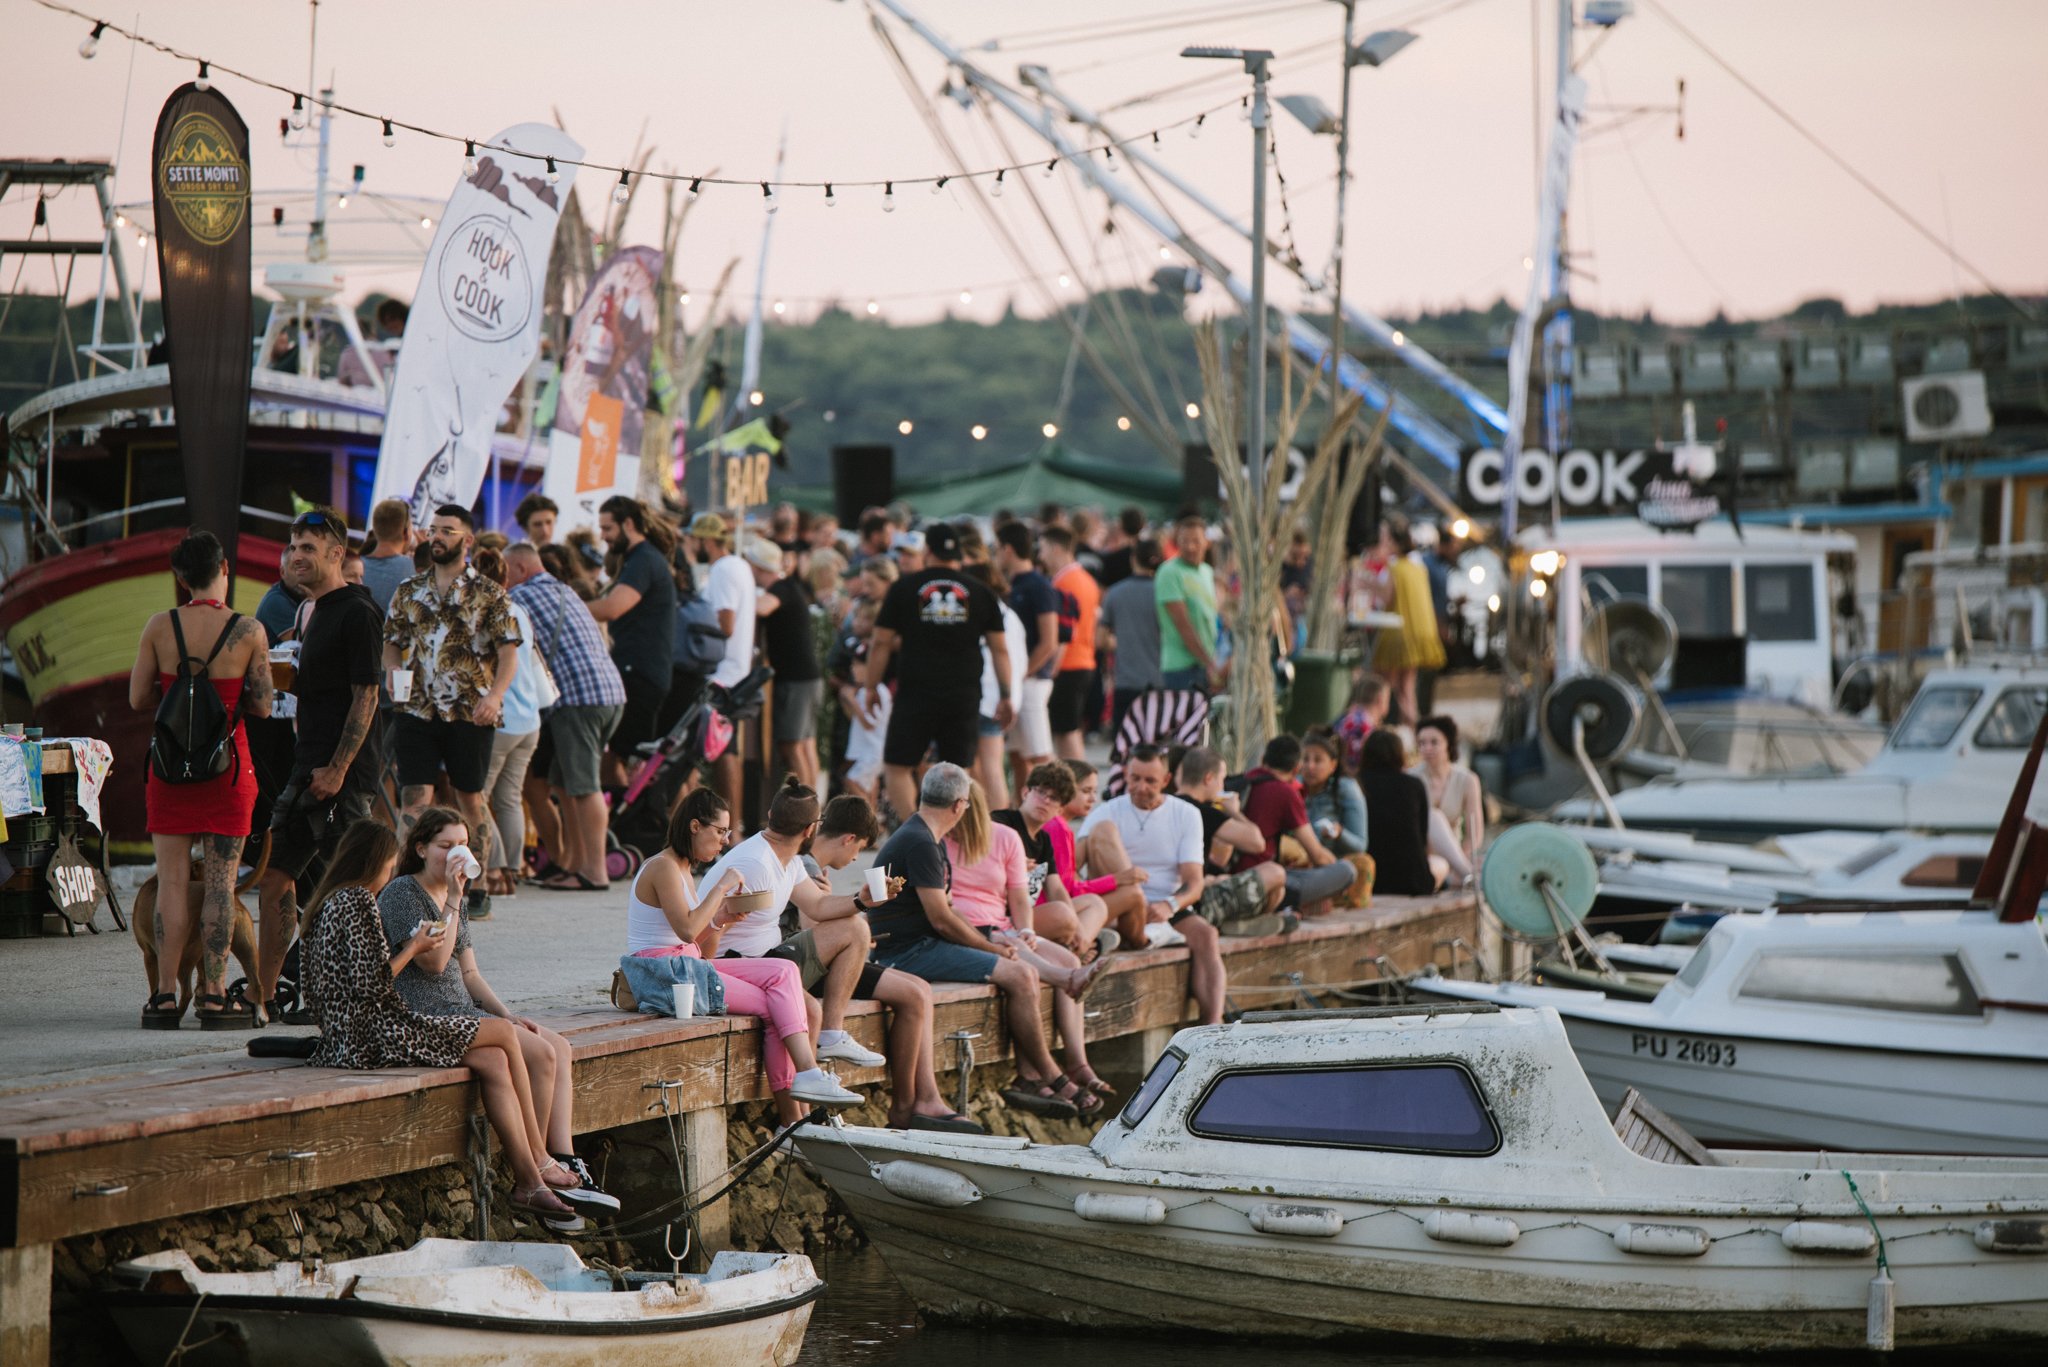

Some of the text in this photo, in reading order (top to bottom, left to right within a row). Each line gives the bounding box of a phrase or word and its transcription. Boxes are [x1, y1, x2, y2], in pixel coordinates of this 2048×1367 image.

[169, 166, 239, 182] SETTE MONTI
[467, 227, 516, 281] HOOK
[479, 266, 489, 284] &
[453, 274, 504, 325] COOK
[726, 452, 770, 510] BAR
[1466, 448, 1647, 506] COOK
[55, 865, 96, 908] SHOP
[1632, 1032, 1738, 1069] PU 2693
